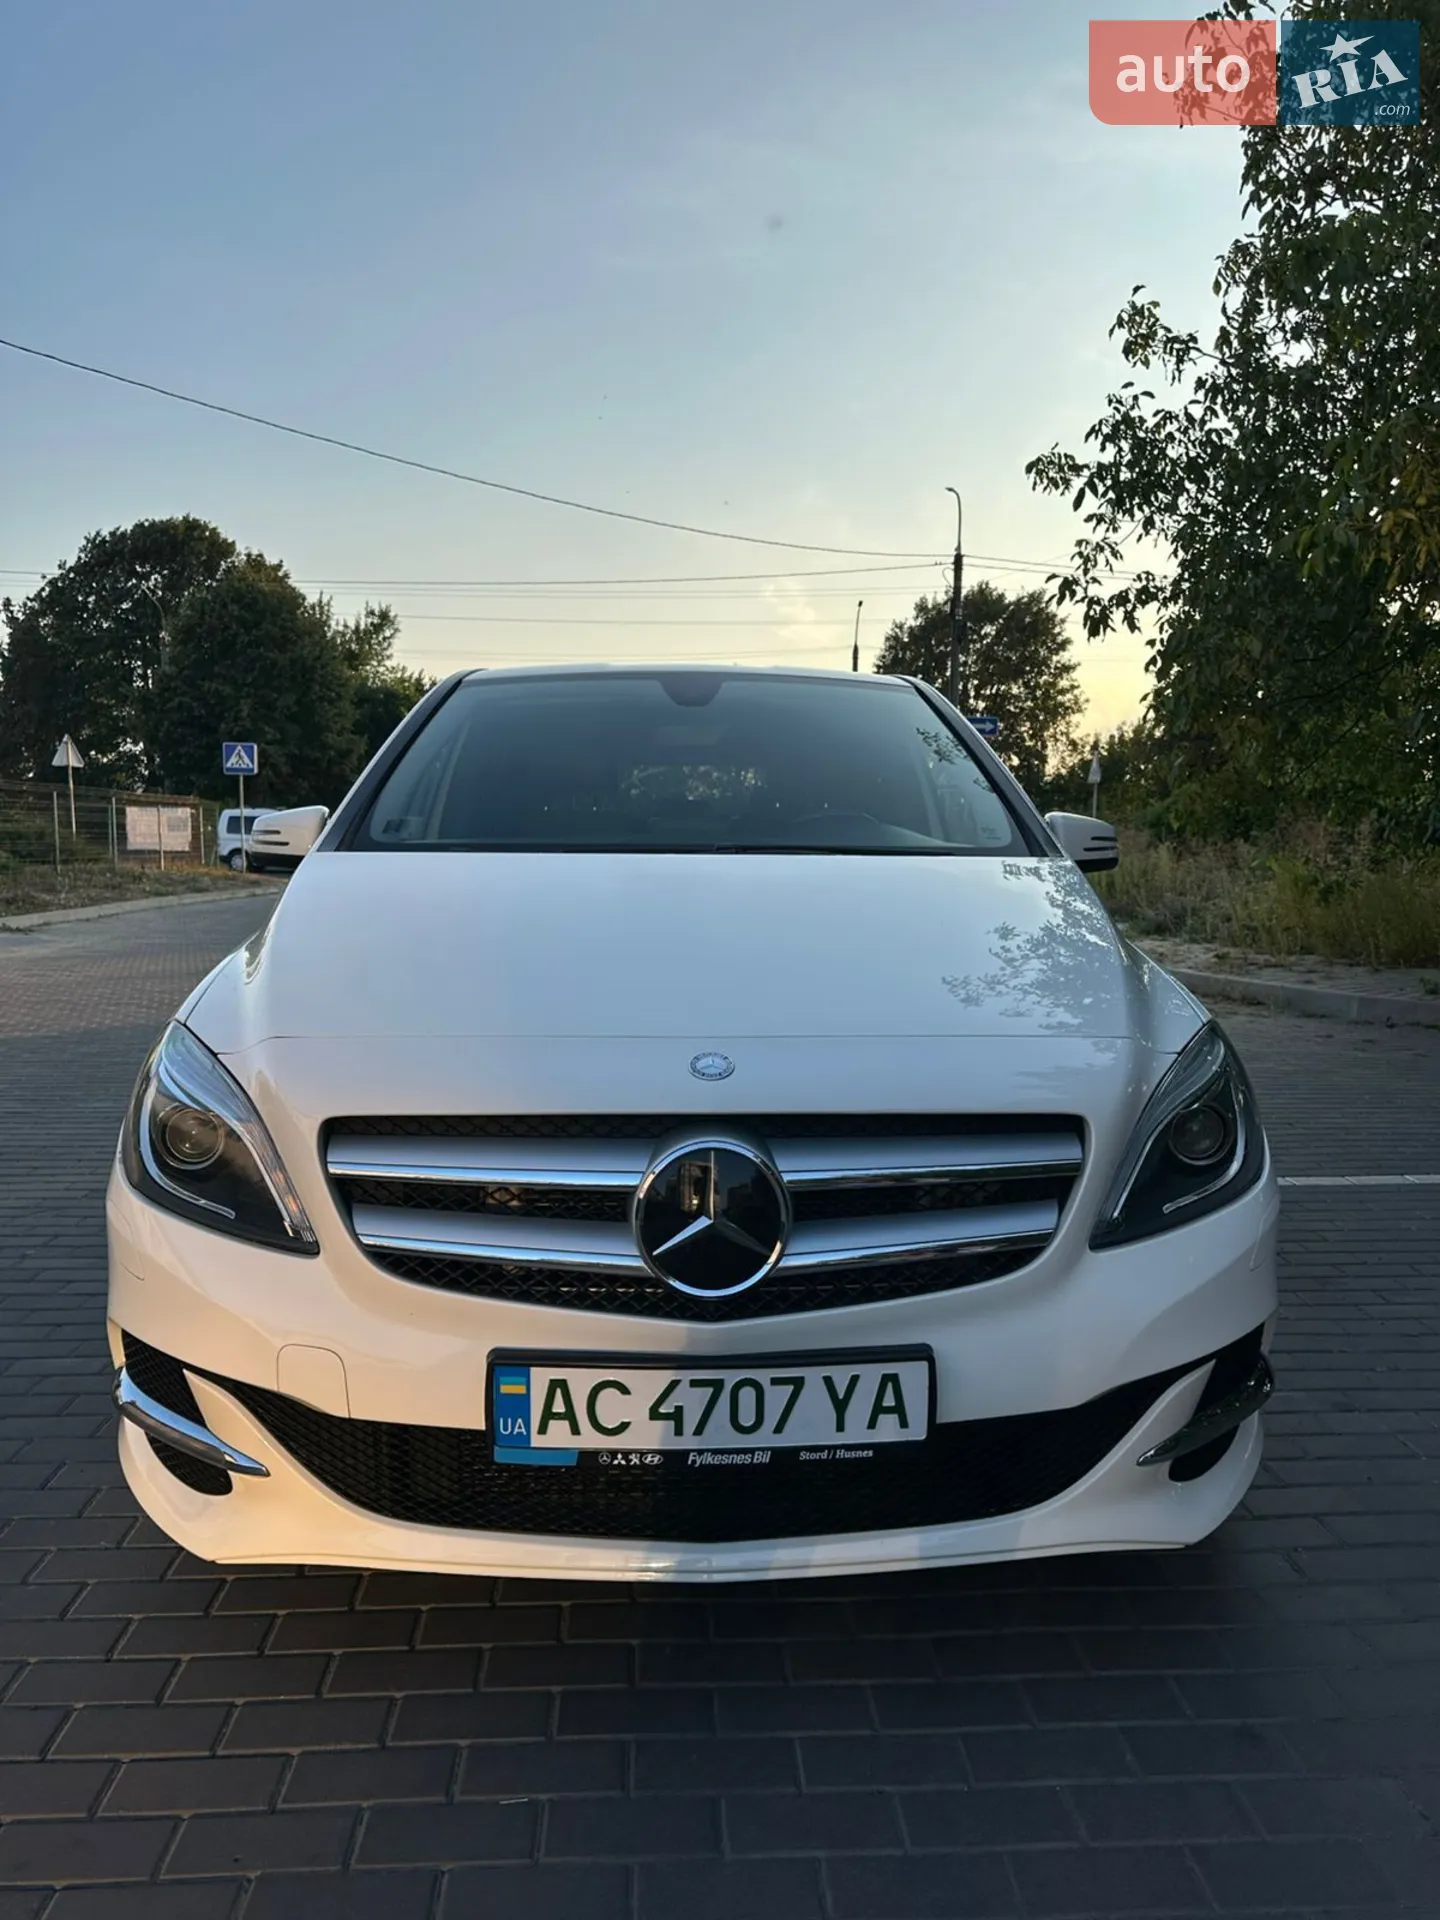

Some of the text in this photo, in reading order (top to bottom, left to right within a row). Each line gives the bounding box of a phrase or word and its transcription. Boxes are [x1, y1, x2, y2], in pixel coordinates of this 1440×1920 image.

[536, 1372, 910, 1437] AC 4707 YA
[499, 1417, 527, 1436] UA
[687, 1450, 772, 1467] Fylkesnes Bil
[799, 1449, 828, 1461] Stord
[835, 1448, 874, 1459] Husnes
